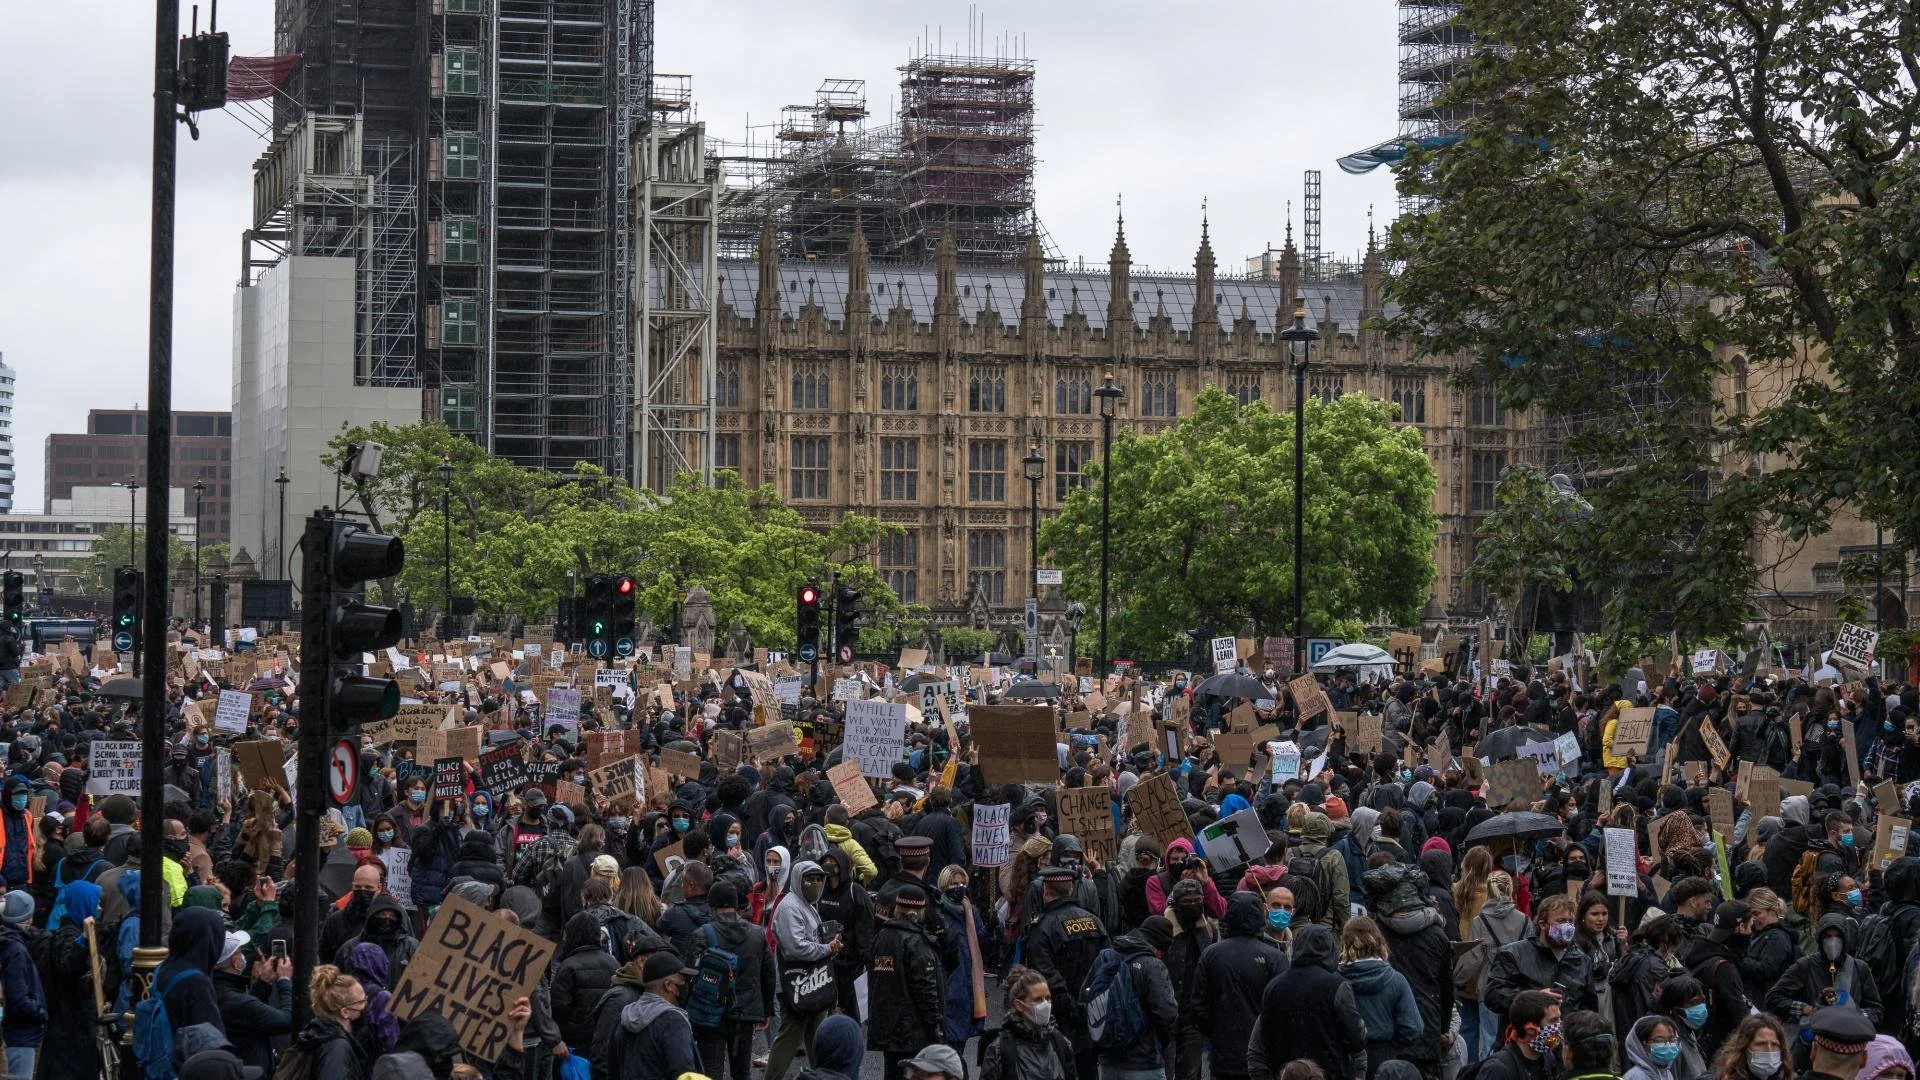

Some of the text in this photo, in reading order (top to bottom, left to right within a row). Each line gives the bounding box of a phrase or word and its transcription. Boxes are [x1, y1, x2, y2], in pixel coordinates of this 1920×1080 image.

[1842, 624, 1875, 643] BLACK
[1214, 638, 1234, 650] LISTEN
[1840, 634, 1868, 650] LIVES
[1216, 650, 1234, 660] LEARN
[1835, 642, 1866, 660] MATTE
[924, 694, 957, 707] LIES
[853, 702, 896, 717] WHILE
[849, 715, 900, 728] WE WAIT
[855, 725, 891, 737] FOR YOU
[1618, 719, 1651, 740] #BLM
[847, 735, 903, 746] TO UNDERSTAND
[94, 750, 120, 759] SCHOOL
[846, 743, 900, 758] WE CANT
[94, 760, 107, 768] BUT
[110, 759, 121, 768] ARE
[437, 762, 460, 772] BLACK
[493, 759, 513, 773] FOR
[526, 762, 560, 774] SILENCE
[603, 758, 636, 781] STAN
[92, 769, 134, 778] LIKELY TO BE
[436, 773, 461, 784] LIVES
[487, 766, 520, 785] BELLY
[533, 774, 545, 783] IS
[109, 780, 140, 790] EXCLUDE
[435, 786, 464, 797] MATTER
[490, 775, 529, 796] MUJINGA
[1128, 774, 1176, 816] BLACK
[1059, 792, 1110, 816] CHANGE
[976, 806, 1010, 824] BLACK
[1147, 797, 1185, 834] LIVES
[1068, 816, 1110, 837] ISN'T
[974, 826, 1005, 845] LIVES
[975, 843, 1009, 865] MATTER
[1084, 838, 1114, 862] LENT
[391, 865, 408, 876] KILL
[1066, 920, 1097, 935] POLICE
[438, 909, 545, 986] BLACK
[433, 955, 513, 1017] LIVES
